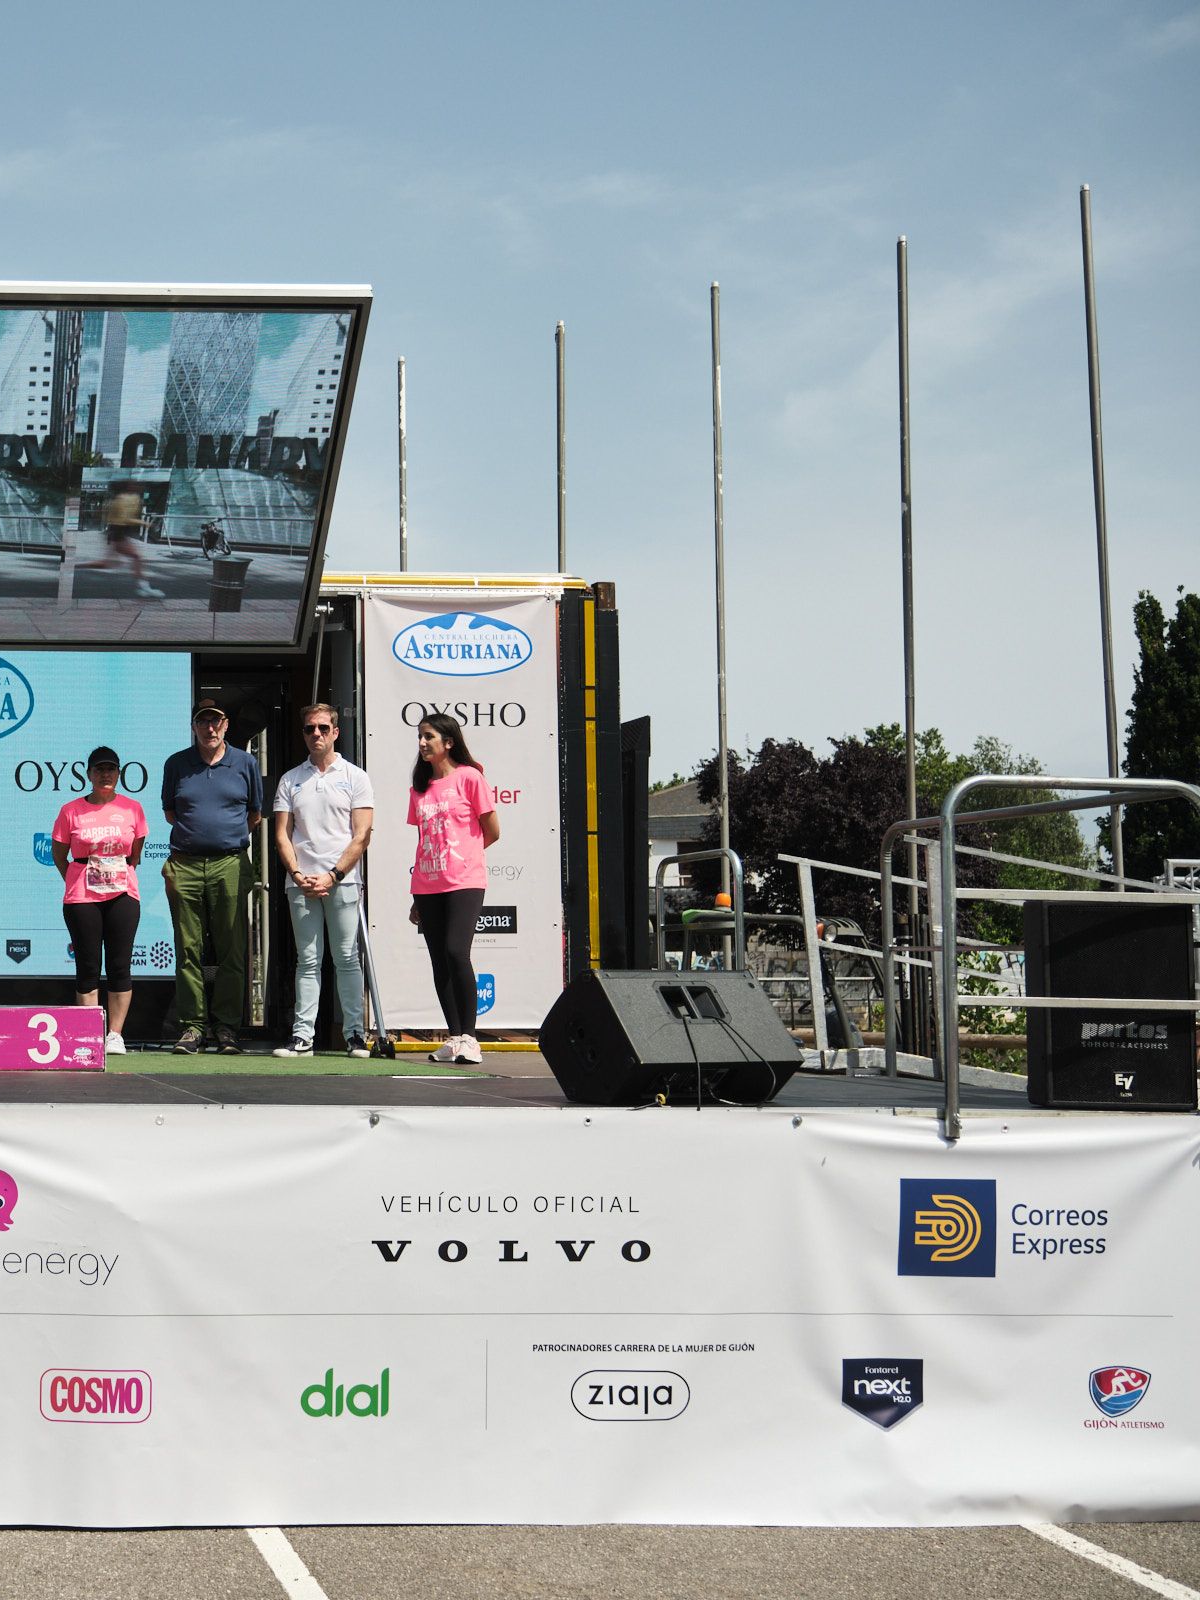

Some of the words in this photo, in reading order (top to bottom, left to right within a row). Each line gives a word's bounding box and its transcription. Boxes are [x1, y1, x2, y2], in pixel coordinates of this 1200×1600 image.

[424, 633, 469, 641] CENTRAL
[403, 635, 522, 660] ASTURIANA
[14, 760, 149, 793] OYSO
[81, 825, 122, 840] CARRERA
[144, 842, 170, 850] Correos
[144, 851, 171, 859] Express
[10, 945, 29, 953] next
[27, 1012, 61, 1065] 3
[1081, 1022, 1168, 1040] portos
[1114, 1073, 1134, 1090] EV
[381, 1191, 519, 1213] VEHÍCULO
[533, 1196, 640, 1213] OFICIAL
[1011, 1203, 1109, 1227] Correos
[371, 1239, 652, 1263] VOLVO
[1012, 1233, 1107, 1260] Express
[2, 1252, 119, 1286] energy
[532, 1344, 612, 1352] PATROCINADORES
[614, 1344, 656, 1353] CARRERA
[658, 1344, 670, 1353] DE
[672, 1344, 683, 1353] LA
[685, 1344, 714, 1353] MUJER
[715, 1344, 726, 1352] DE
[728, 1342, 755, 1352] GIJÓN
[865, 1366, 899, 1374] Fontarel
[49, 1375, 144, 1415] COSMO
[300, 1367, 390, 1418] dial
[854, 1377, 911, 1395] next
[588, 1384, 673, 1414] ziaja
[1084, 1418, 1118, 1430] GIJÓN
[1120, 1421, 1165, 1429] ATLETISMO
